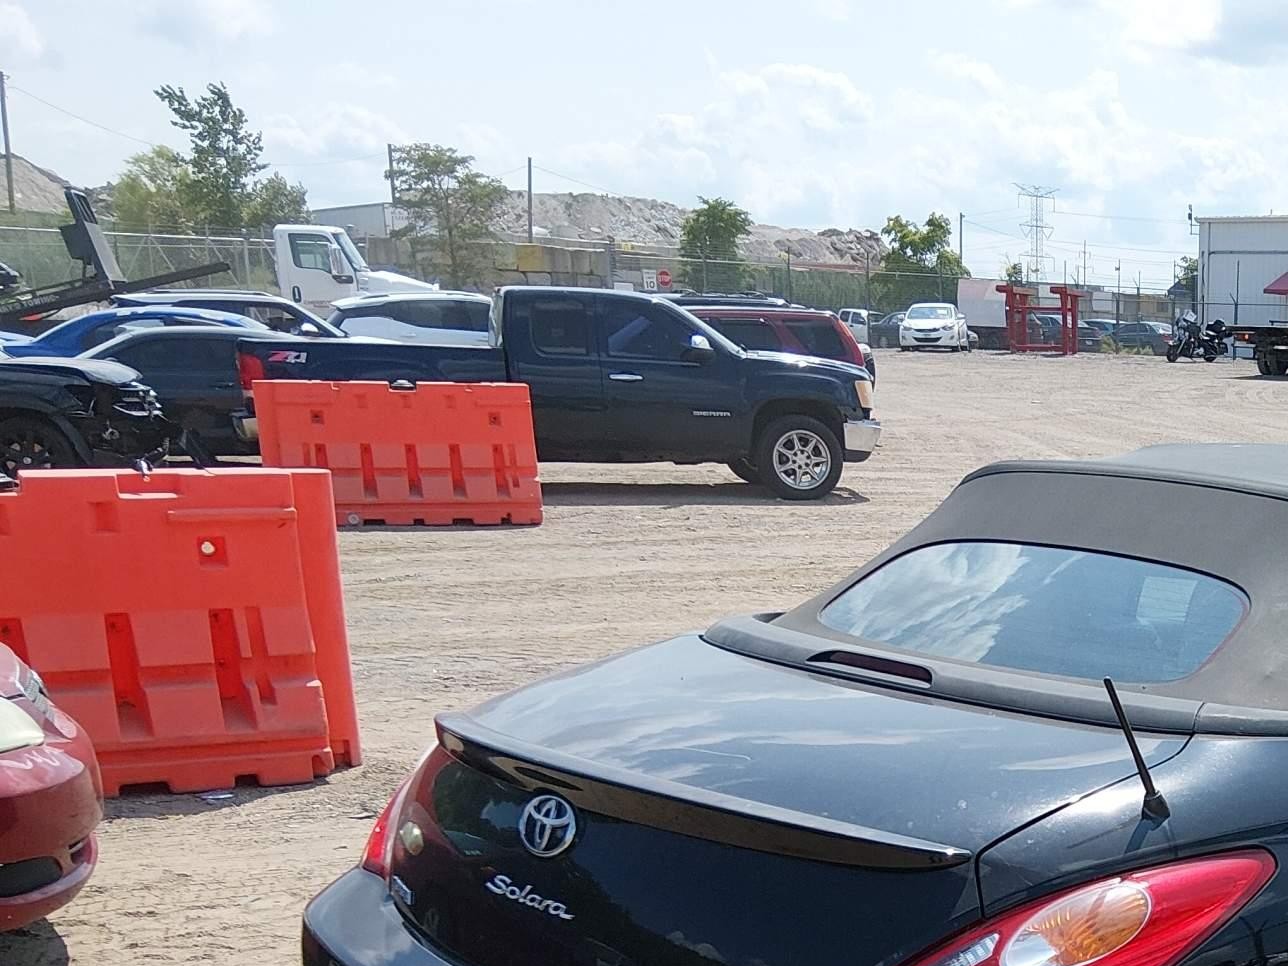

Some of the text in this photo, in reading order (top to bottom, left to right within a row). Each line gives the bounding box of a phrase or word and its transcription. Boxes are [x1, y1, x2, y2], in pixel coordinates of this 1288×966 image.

[645, 280, 656, 289] 10
[268, 350, 308, 364] Z71
[485, 874, 577, 920] Solara
